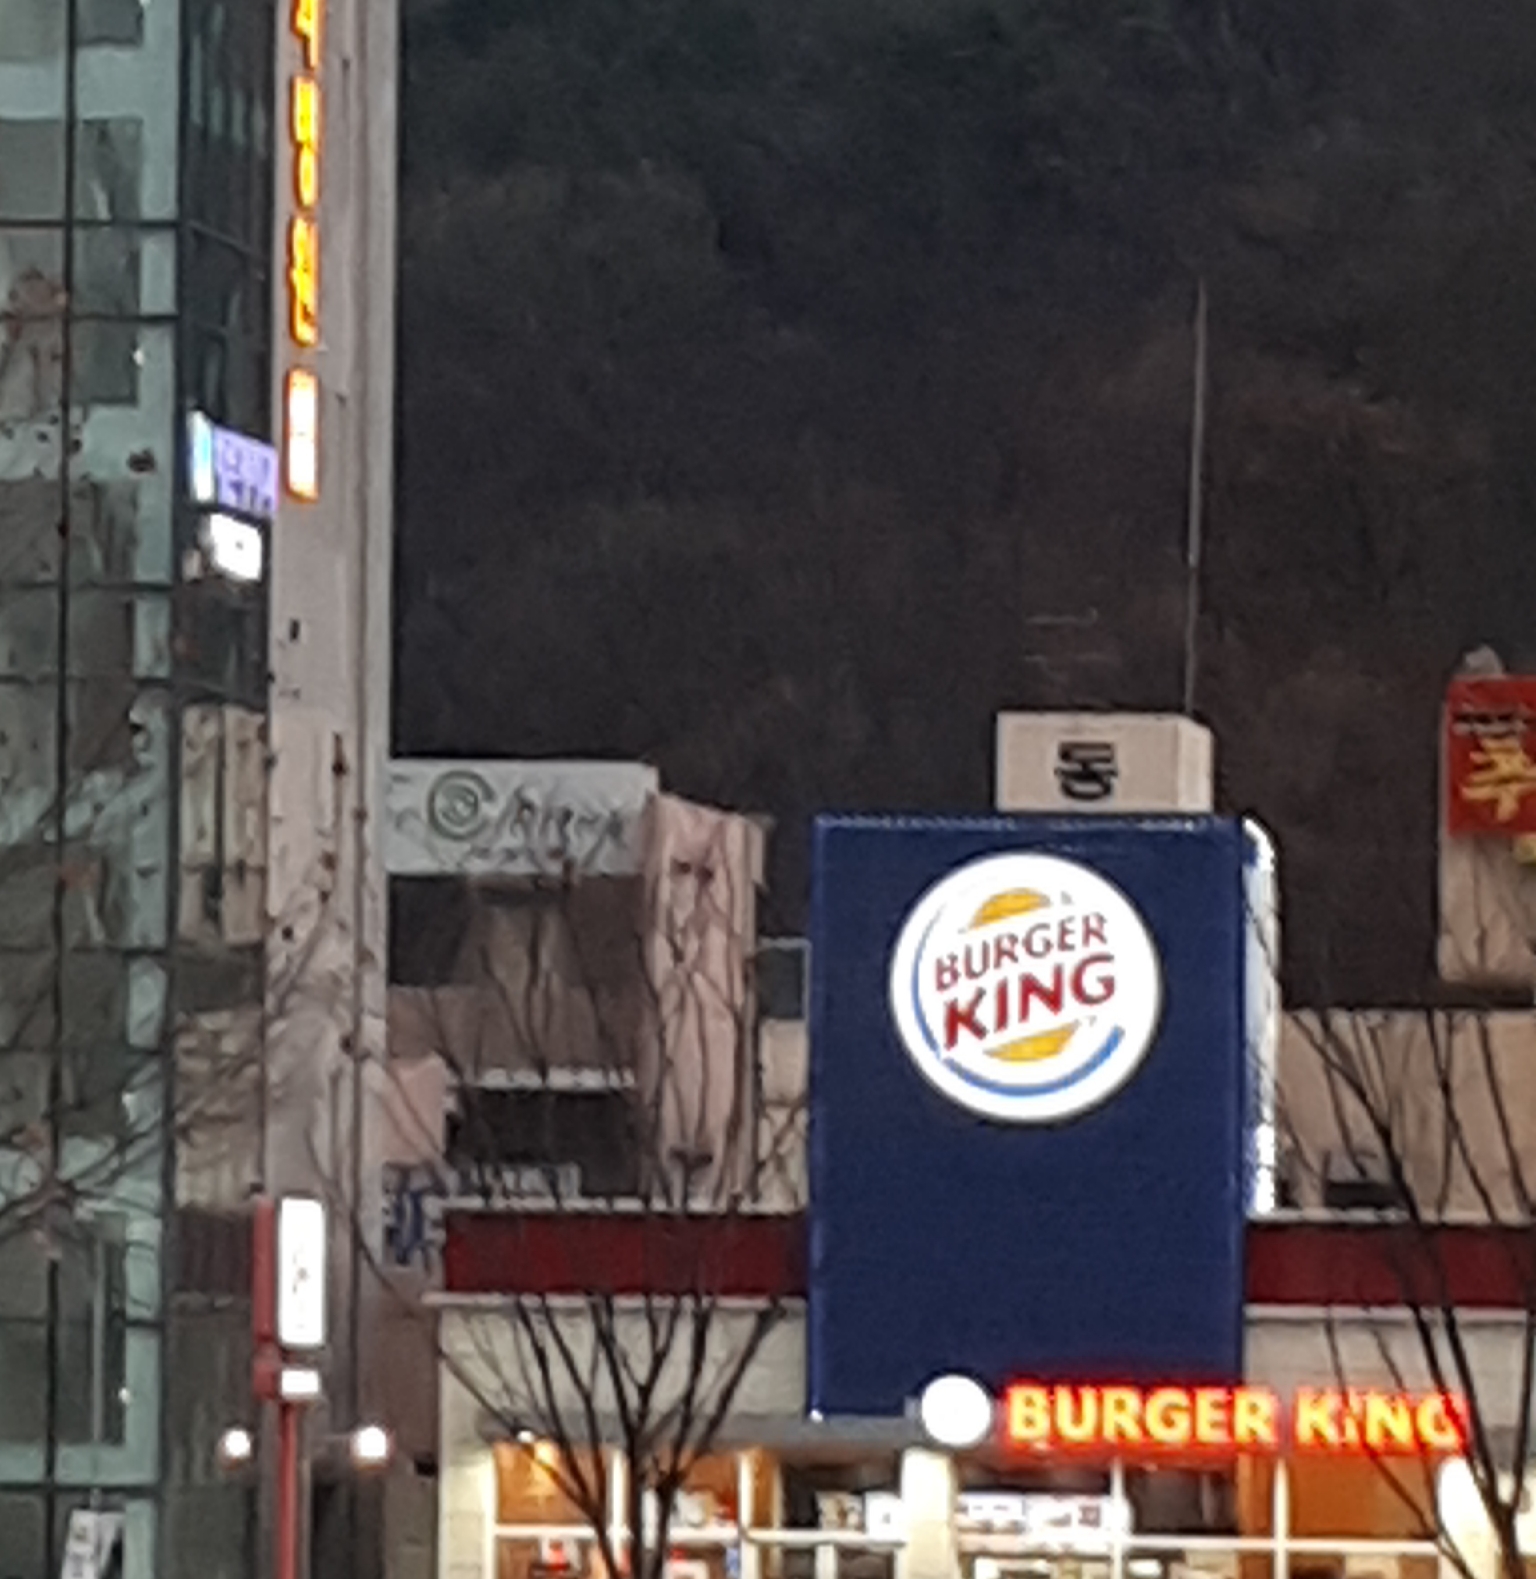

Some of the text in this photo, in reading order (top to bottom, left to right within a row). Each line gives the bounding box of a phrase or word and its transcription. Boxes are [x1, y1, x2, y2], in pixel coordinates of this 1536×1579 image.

[933, 912, 1108, 992] BURGER
[943, 953, 1116, 1052] KING
[1005, 1385, 1468, 1450] BURGER KING
